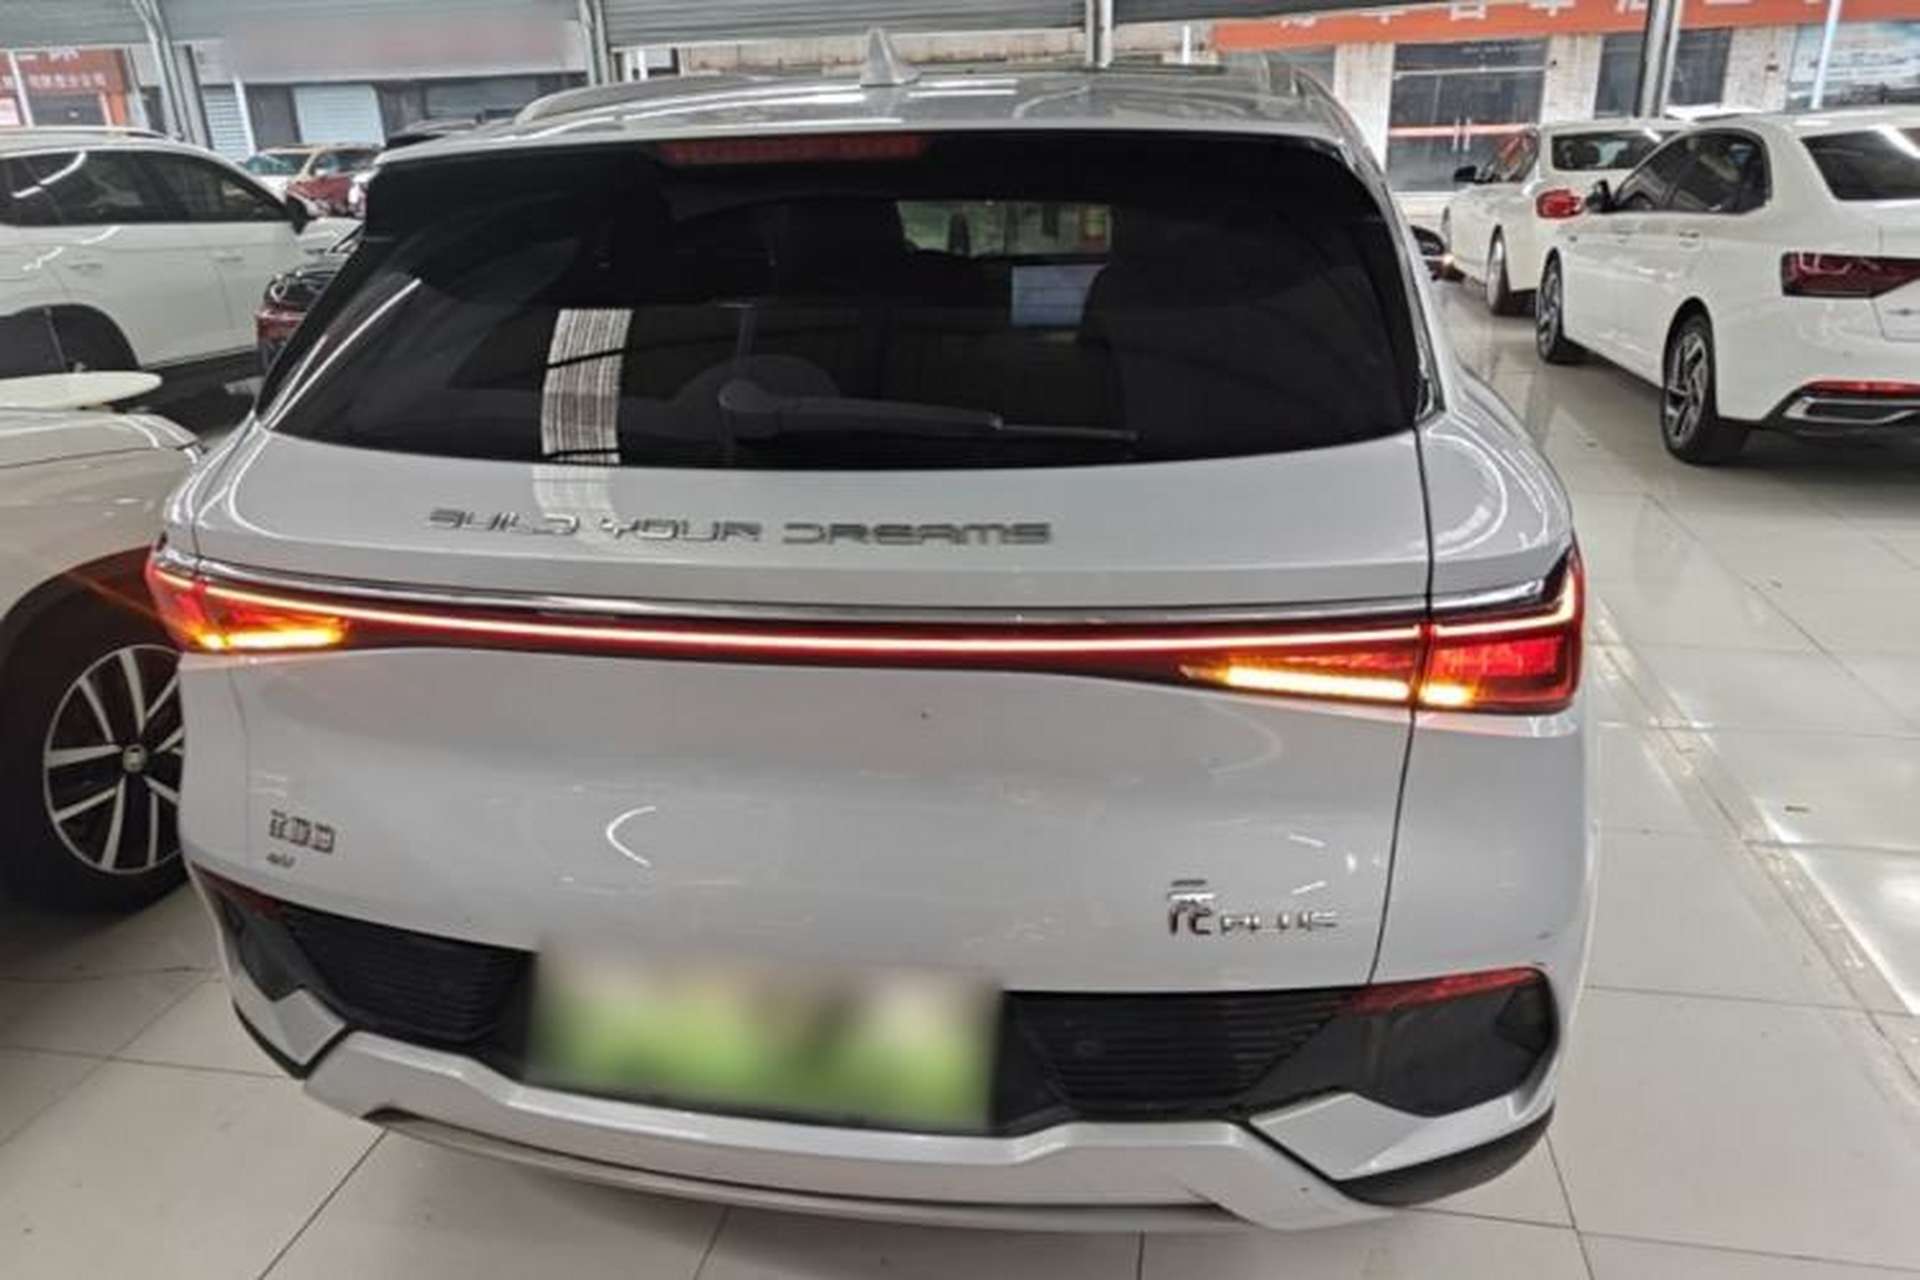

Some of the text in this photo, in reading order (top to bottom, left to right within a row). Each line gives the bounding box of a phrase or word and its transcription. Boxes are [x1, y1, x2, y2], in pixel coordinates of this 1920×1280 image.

[429, 507, 1052, 545] BUILD YOUR DREAMS
